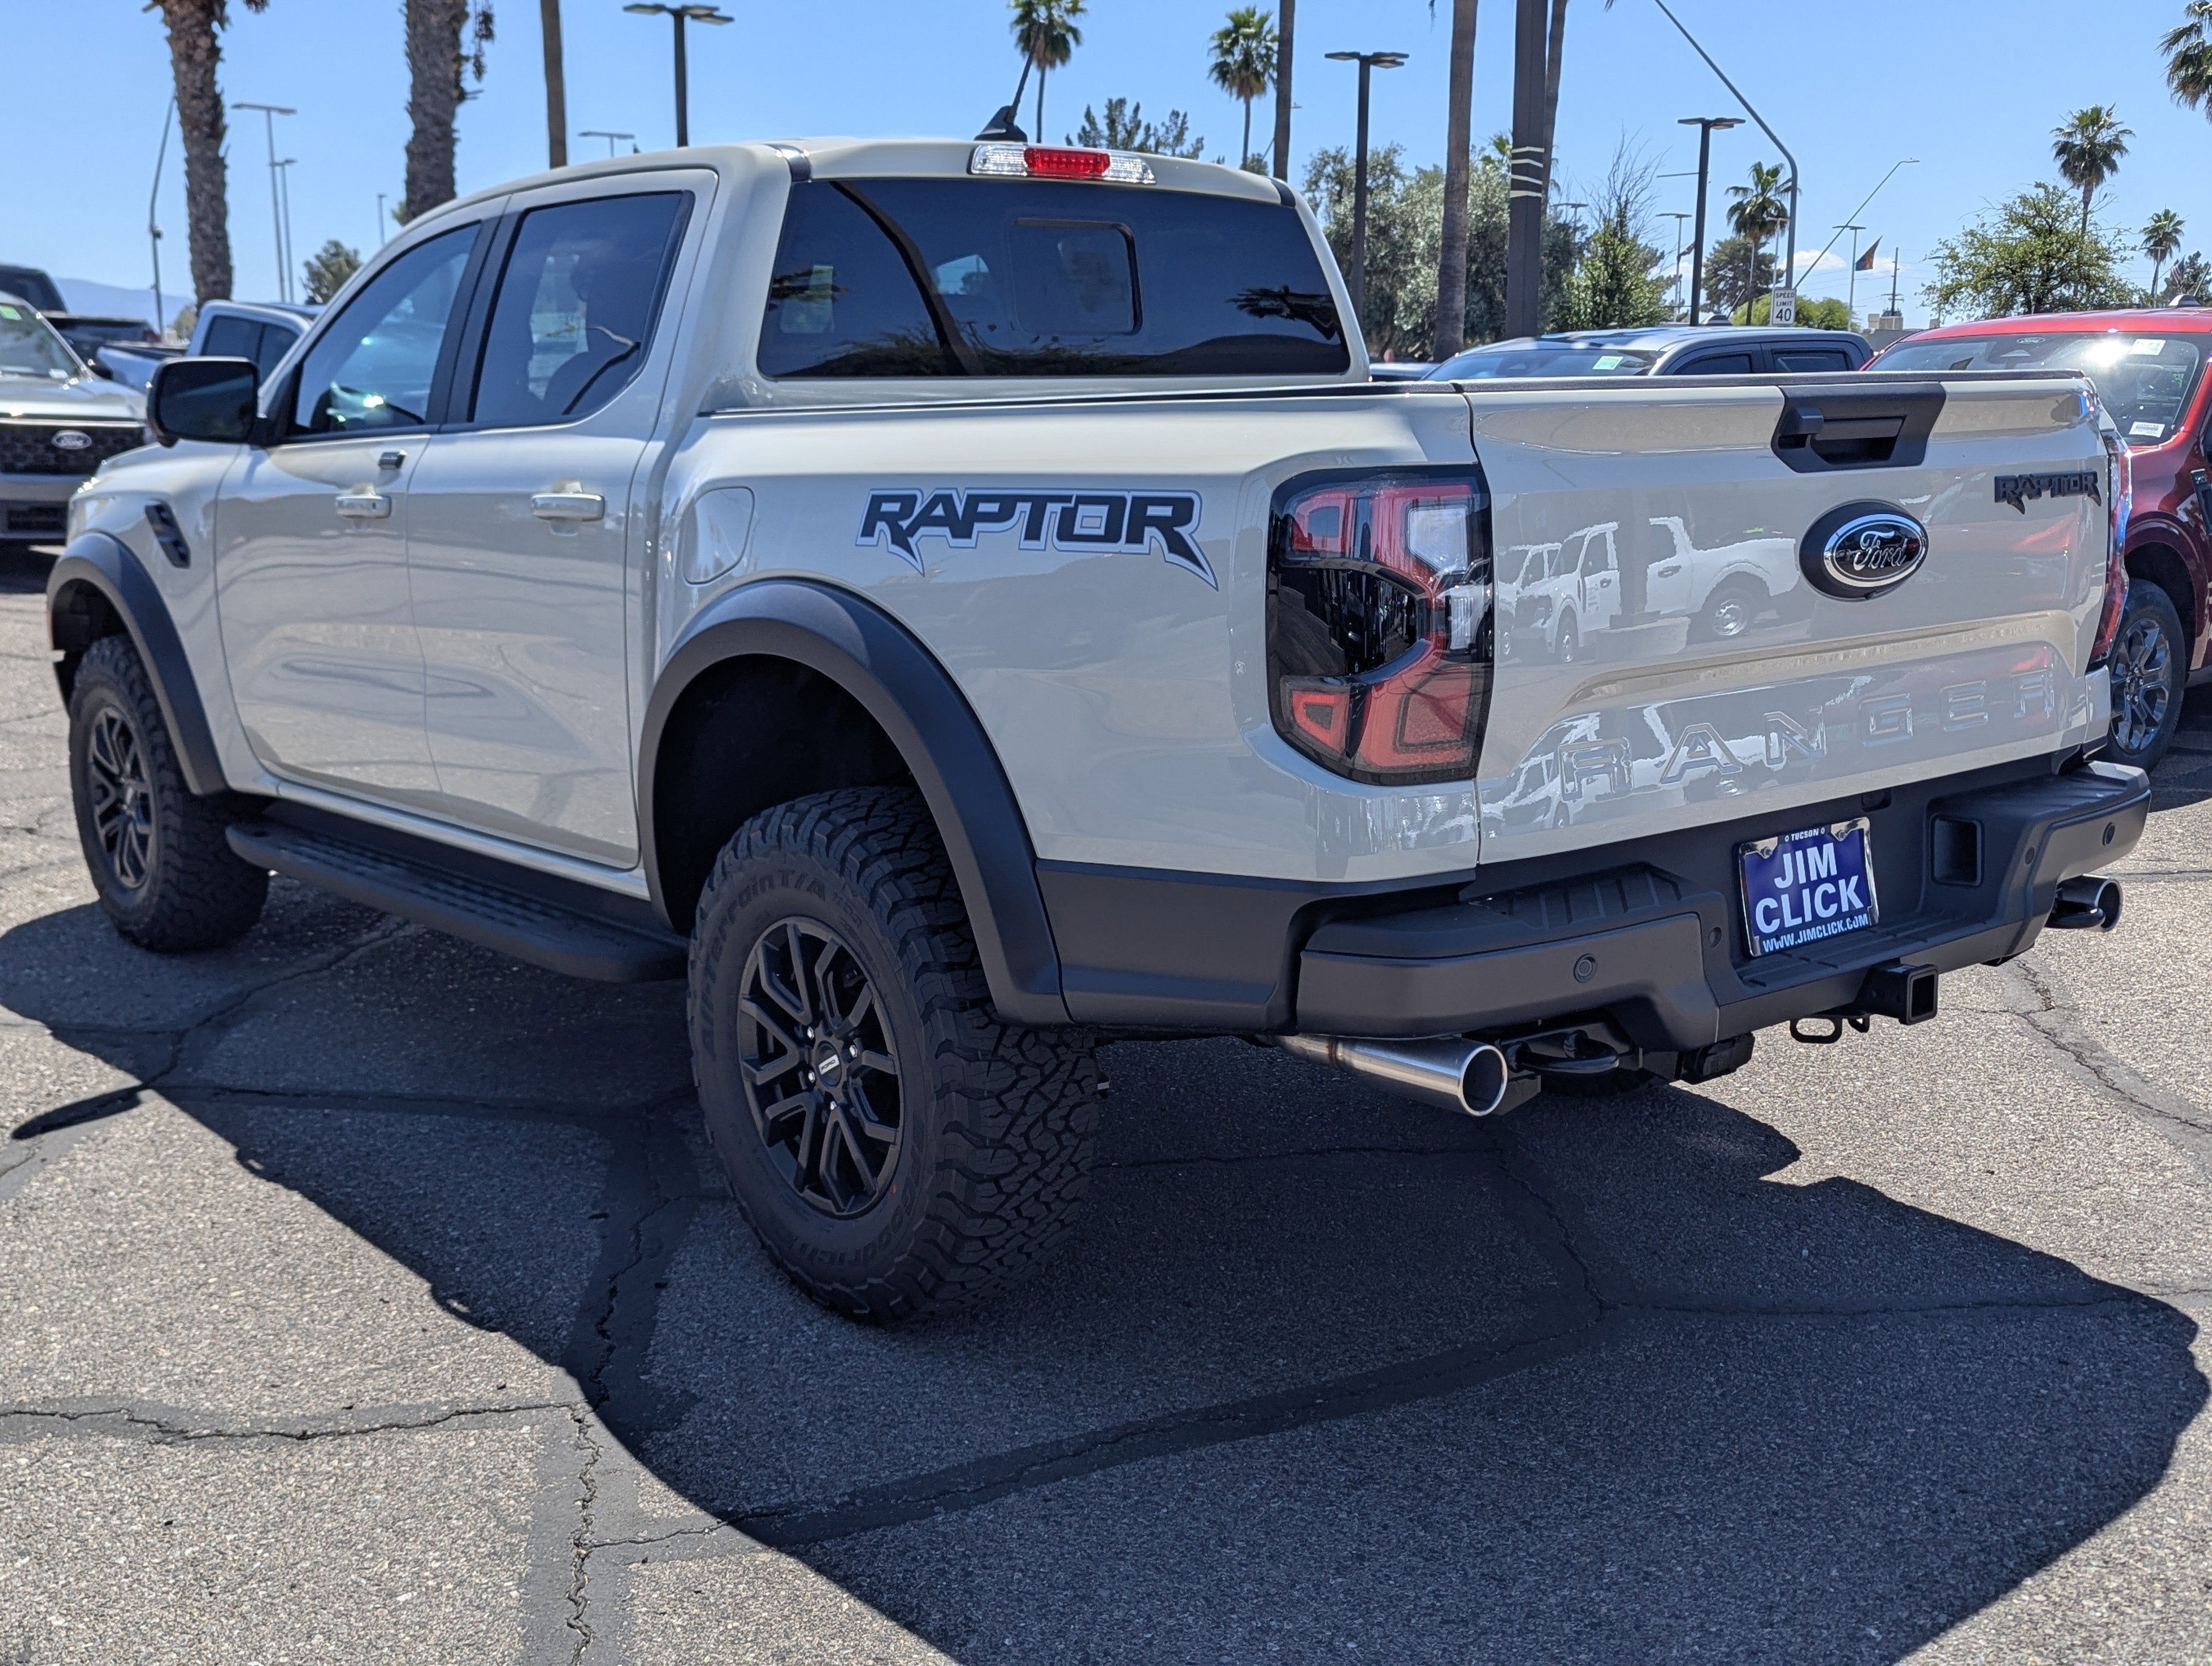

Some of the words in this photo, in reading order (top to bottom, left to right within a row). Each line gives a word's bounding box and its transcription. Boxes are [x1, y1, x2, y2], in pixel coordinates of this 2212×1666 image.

[1776, 308, 1791, 322] 40
[1994, 470, 2102, 515] RAPTOR
[855, 487, 1219, 592] RAPTOR
[1853, 529, 1907, 571] Ford
[1557, 669, 2054, 802] RANGER
[1791, 828, 1819, 841] TUCSON
[1774, 842, 1837, 889] JIM
[1755, 875, 1864, 934] CLICK
[1762, 913, 1869, 953] WWW.JIMCLICK.COM
